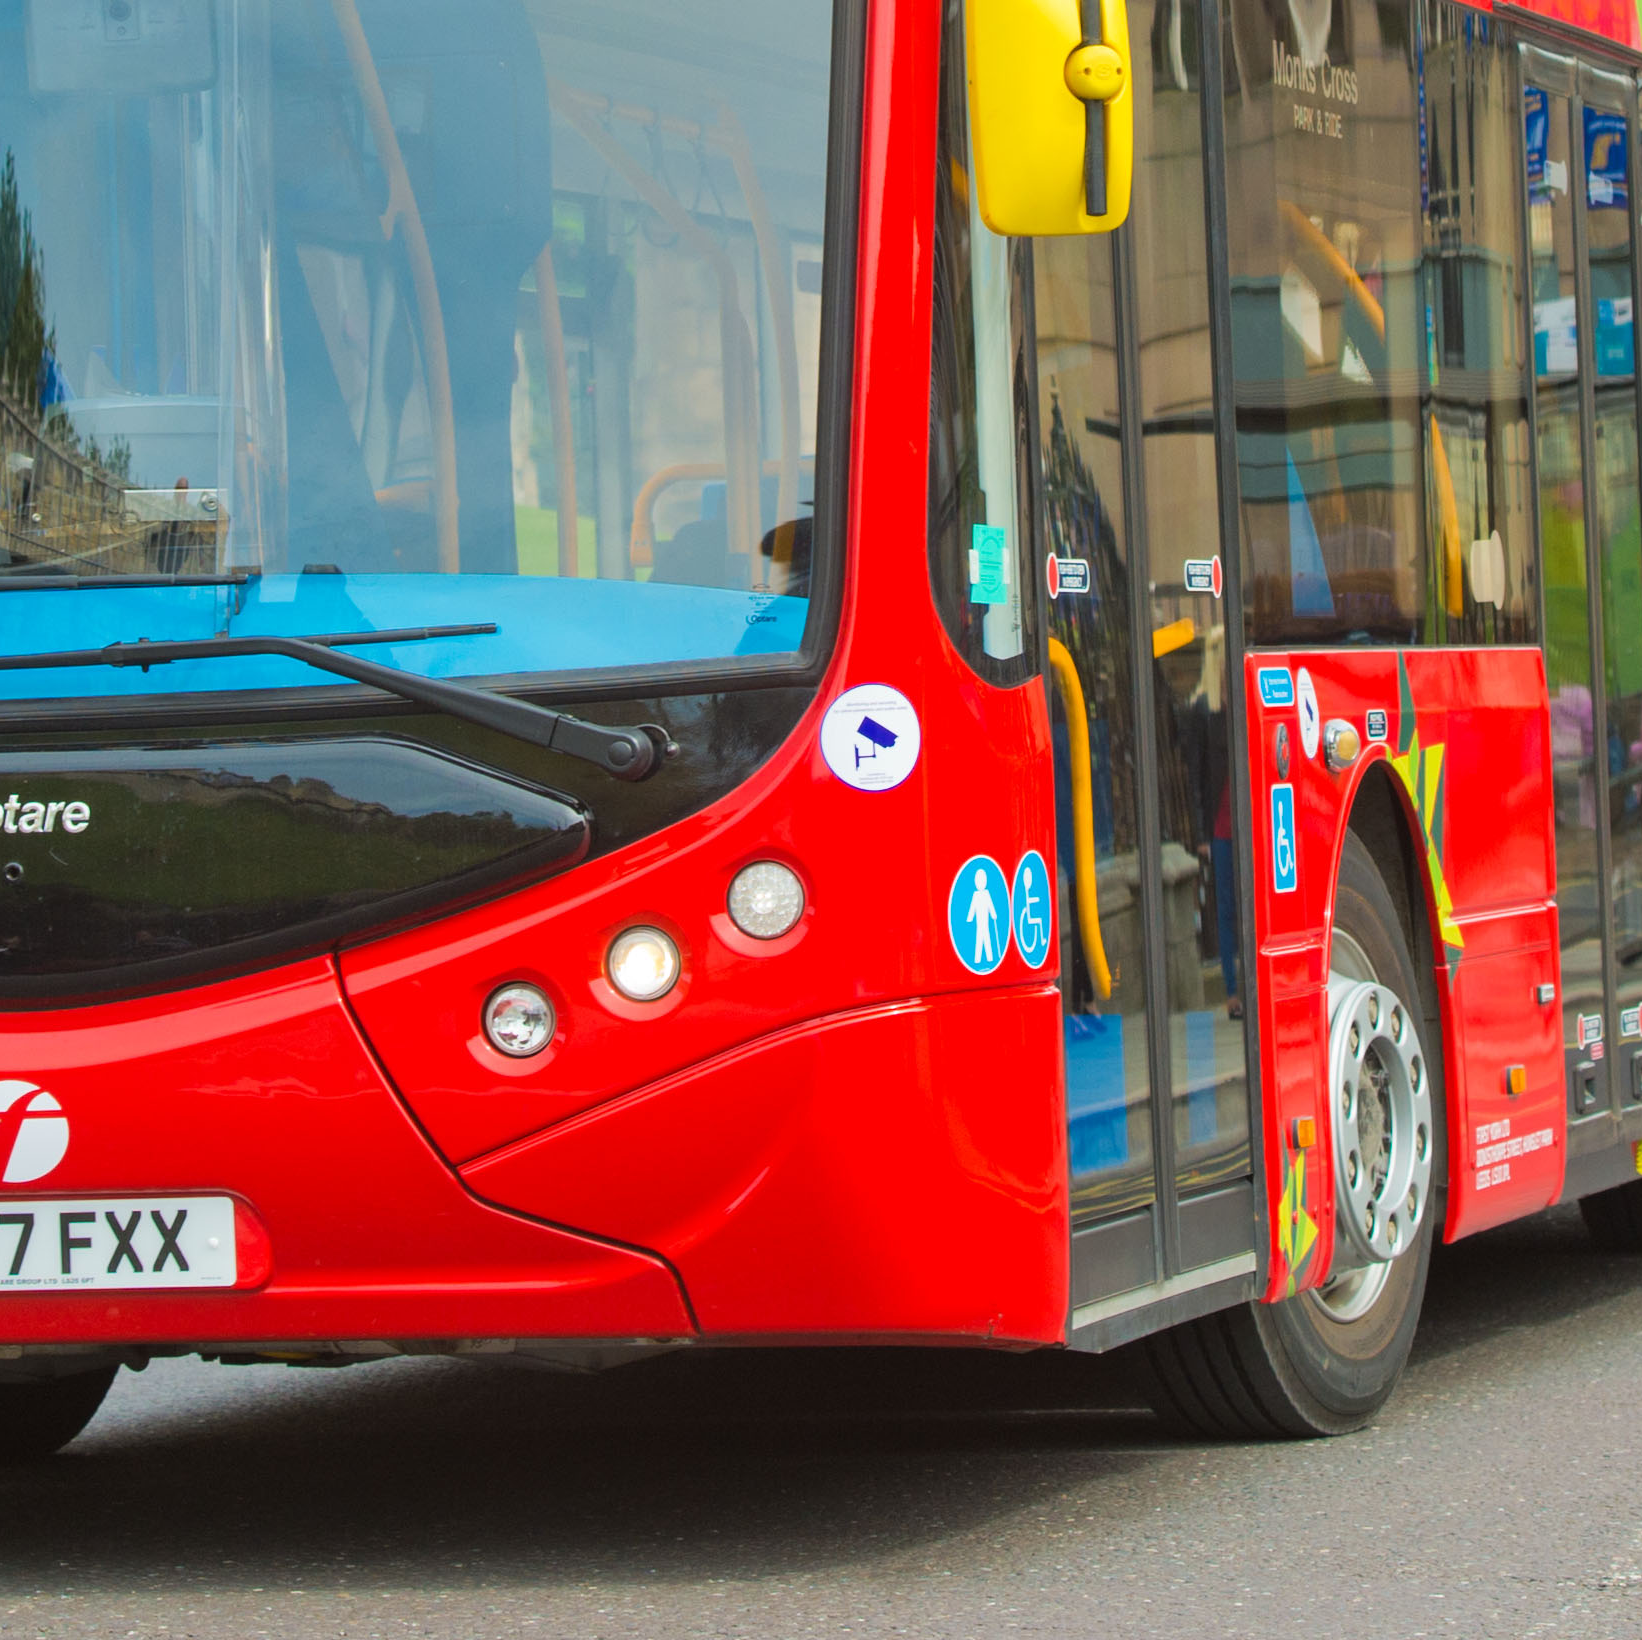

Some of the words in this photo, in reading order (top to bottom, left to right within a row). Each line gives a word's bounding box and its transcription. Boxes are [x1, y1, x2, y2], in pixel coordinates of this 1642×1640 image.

[1272, 39, 1317, 96] Monks
[1321, 51, 1358, 105] Cross
[1292, 103, 1315, 133] PARK
[1317, 108, 1324, 136] &
[1324, 111, 1344, 139] RIDE
[59, 1209, 189, 1274] FXX
